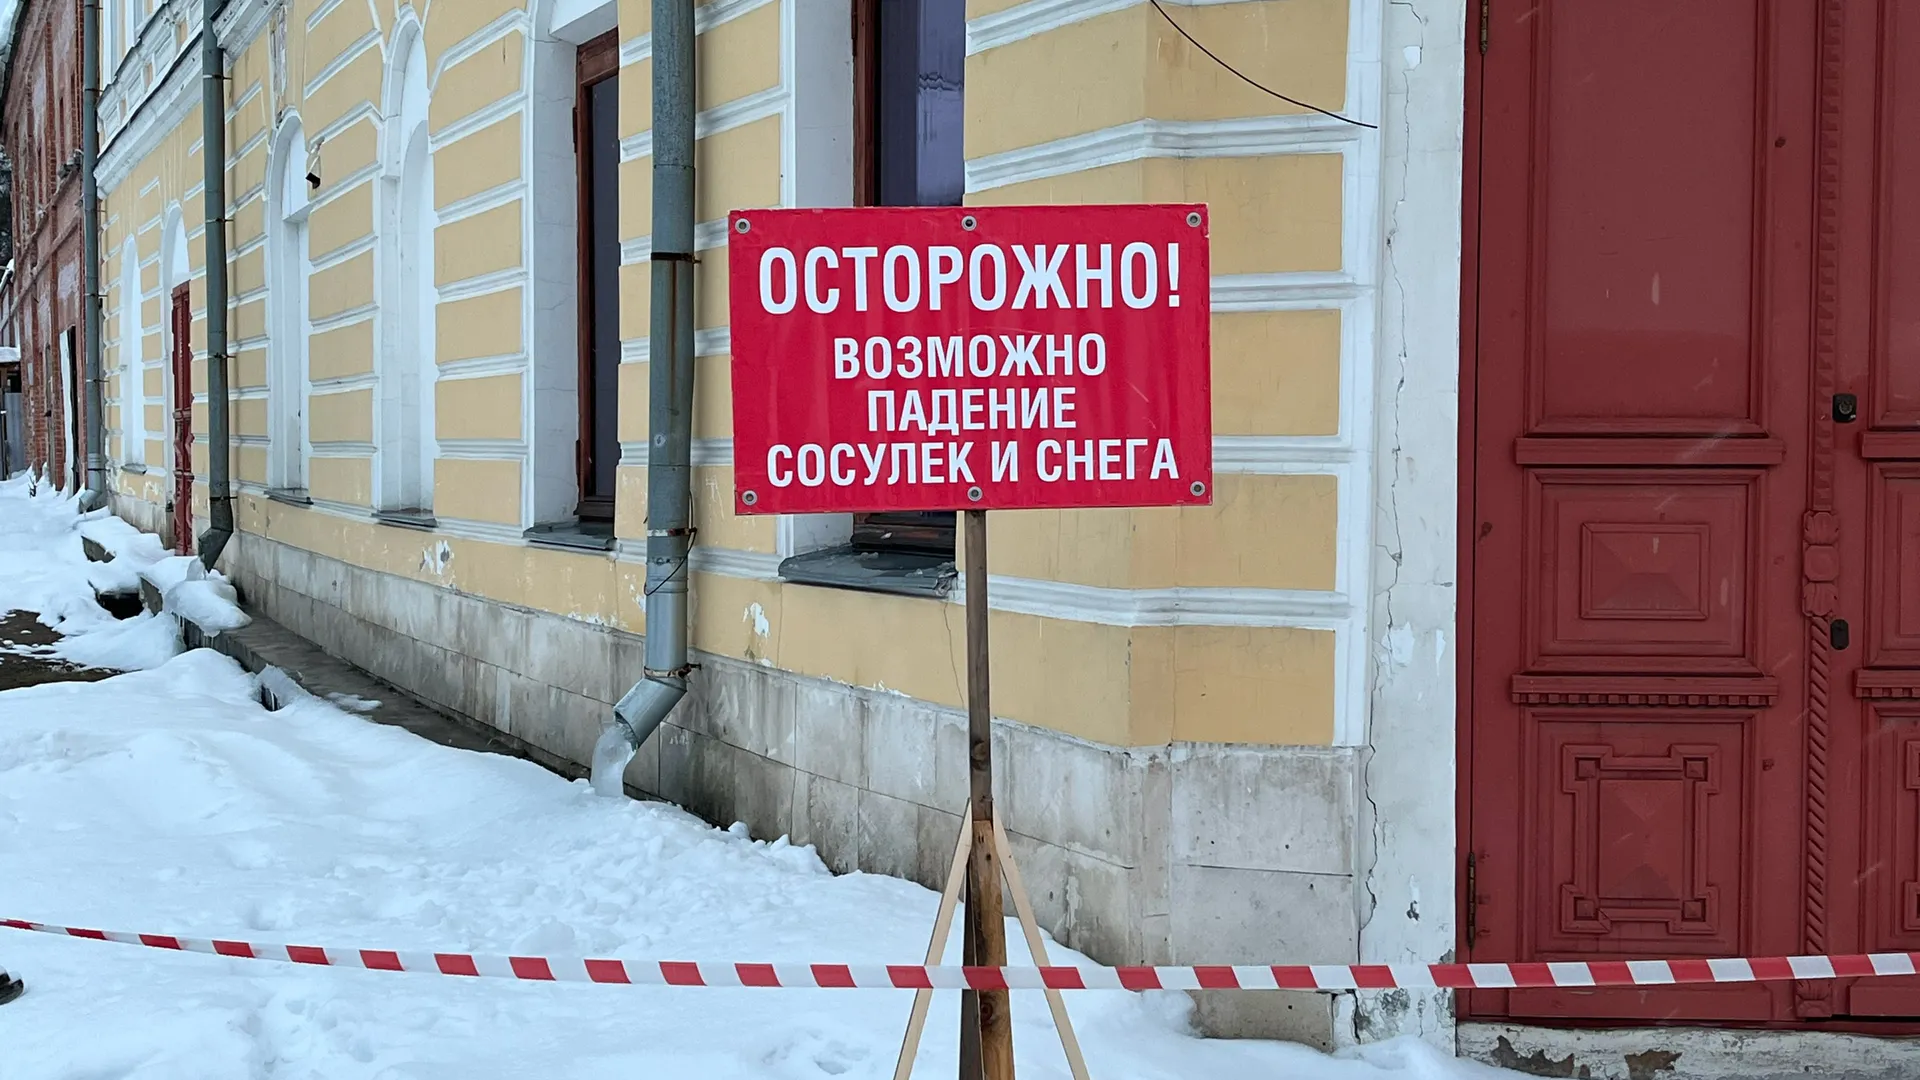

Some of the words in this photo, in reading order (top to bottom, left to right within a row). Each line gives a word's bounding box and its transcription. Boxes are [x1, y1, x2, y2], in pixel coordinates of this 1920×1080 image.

[759, 242, 1180, 314] ОСТОРОЖНО!
[834, 334, 1106, 379] ВОЗМОЖНО
[867, 387, 1077, 436] ПАДЕНИЕ
[767, 442, 976, 487] СОСУЛЕК
[991, 440, 1019, 482] И
[1036, 438, 1180, 482] СНЕГА
